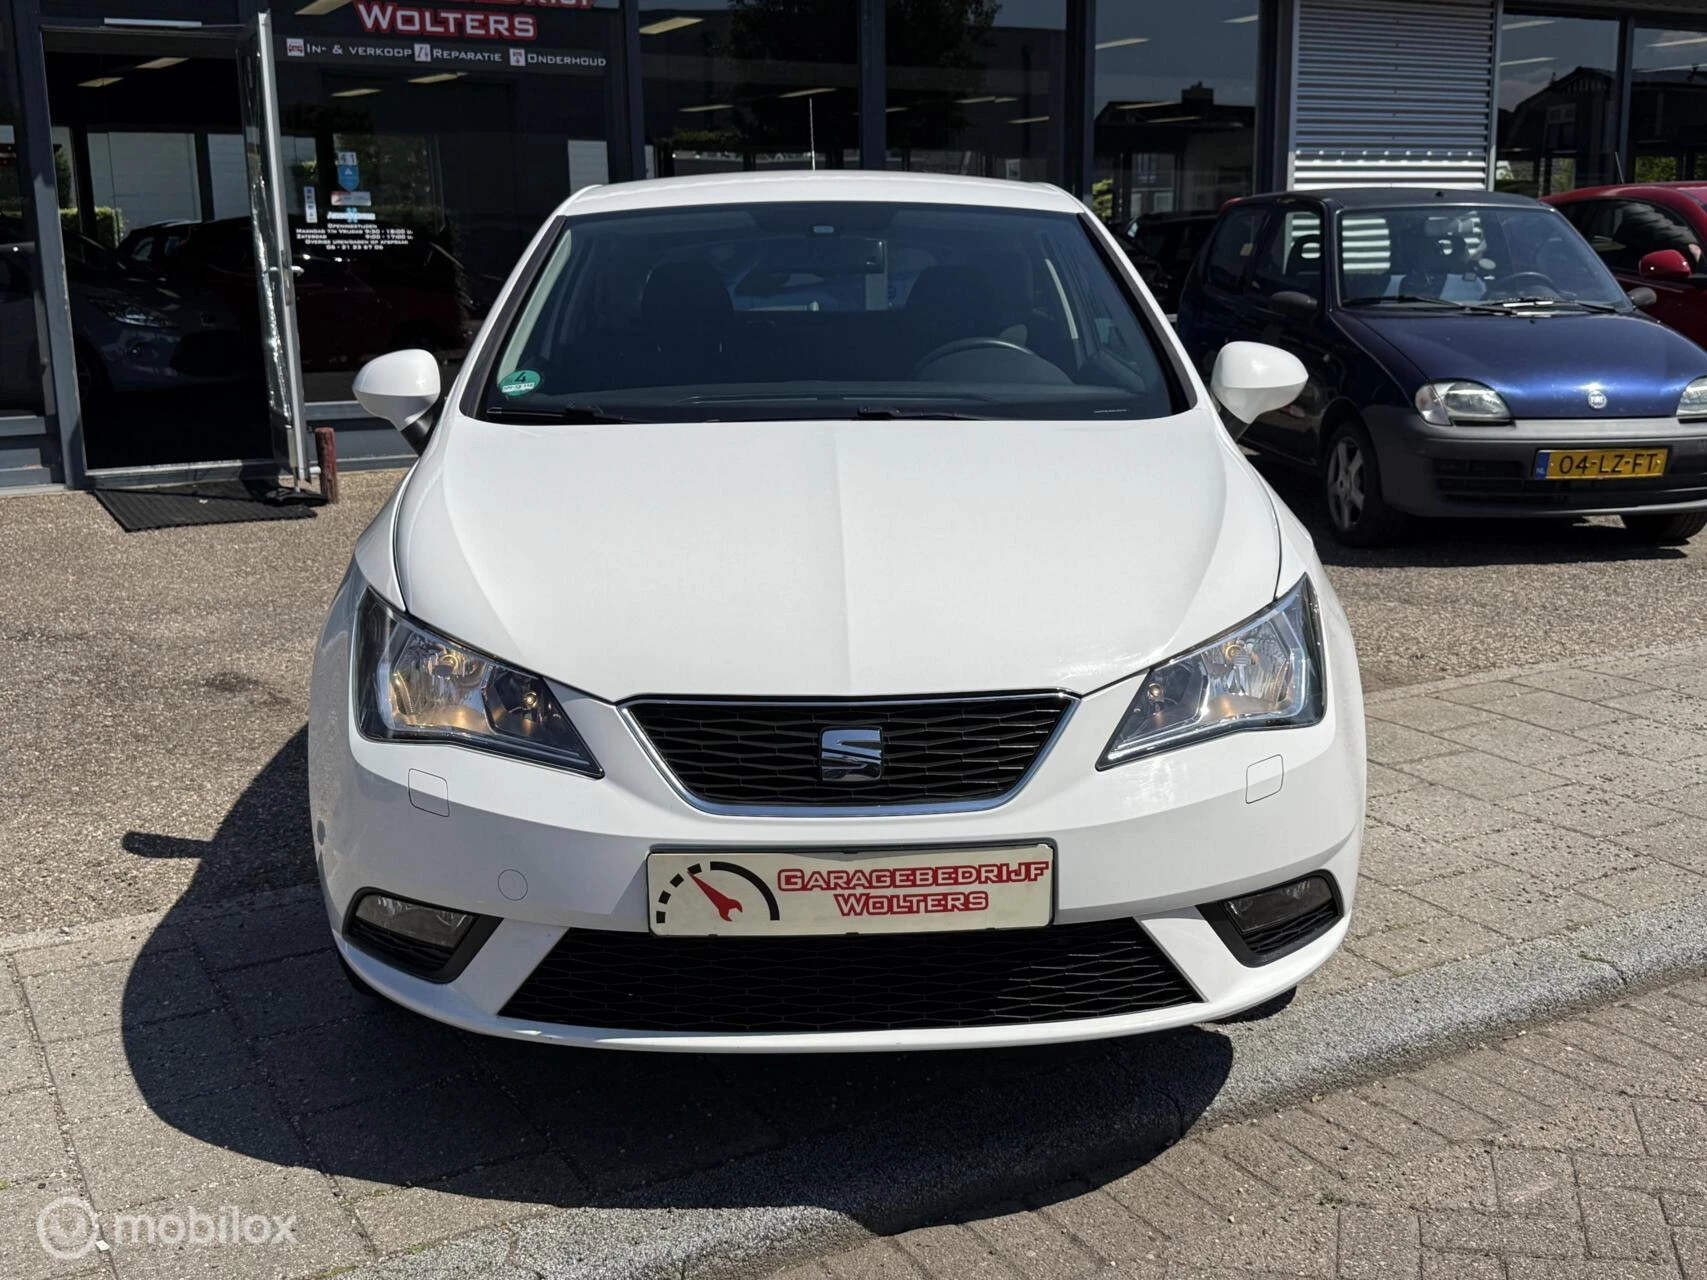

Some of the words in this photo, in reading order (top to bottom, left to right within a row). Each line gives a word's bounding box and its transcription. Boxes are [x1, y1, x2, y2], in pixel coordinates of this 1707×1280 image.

[357, 3, 537, 39] WOLTERS
[332, 44, 344, 55] &
[349, 46, 412, 58] VERKOOP
[433, 49, 502, 62] REPARATIE
[527, 53, 606, 67] ONDERHOUD
[514, 372, 526, 382] 4
[1559, 453, 1658, 475] 04-LZ-FT
[777, 861, 1050, 892] GARAGEBEDRIJF
[834, 891, 989, 917] WOLTERS
